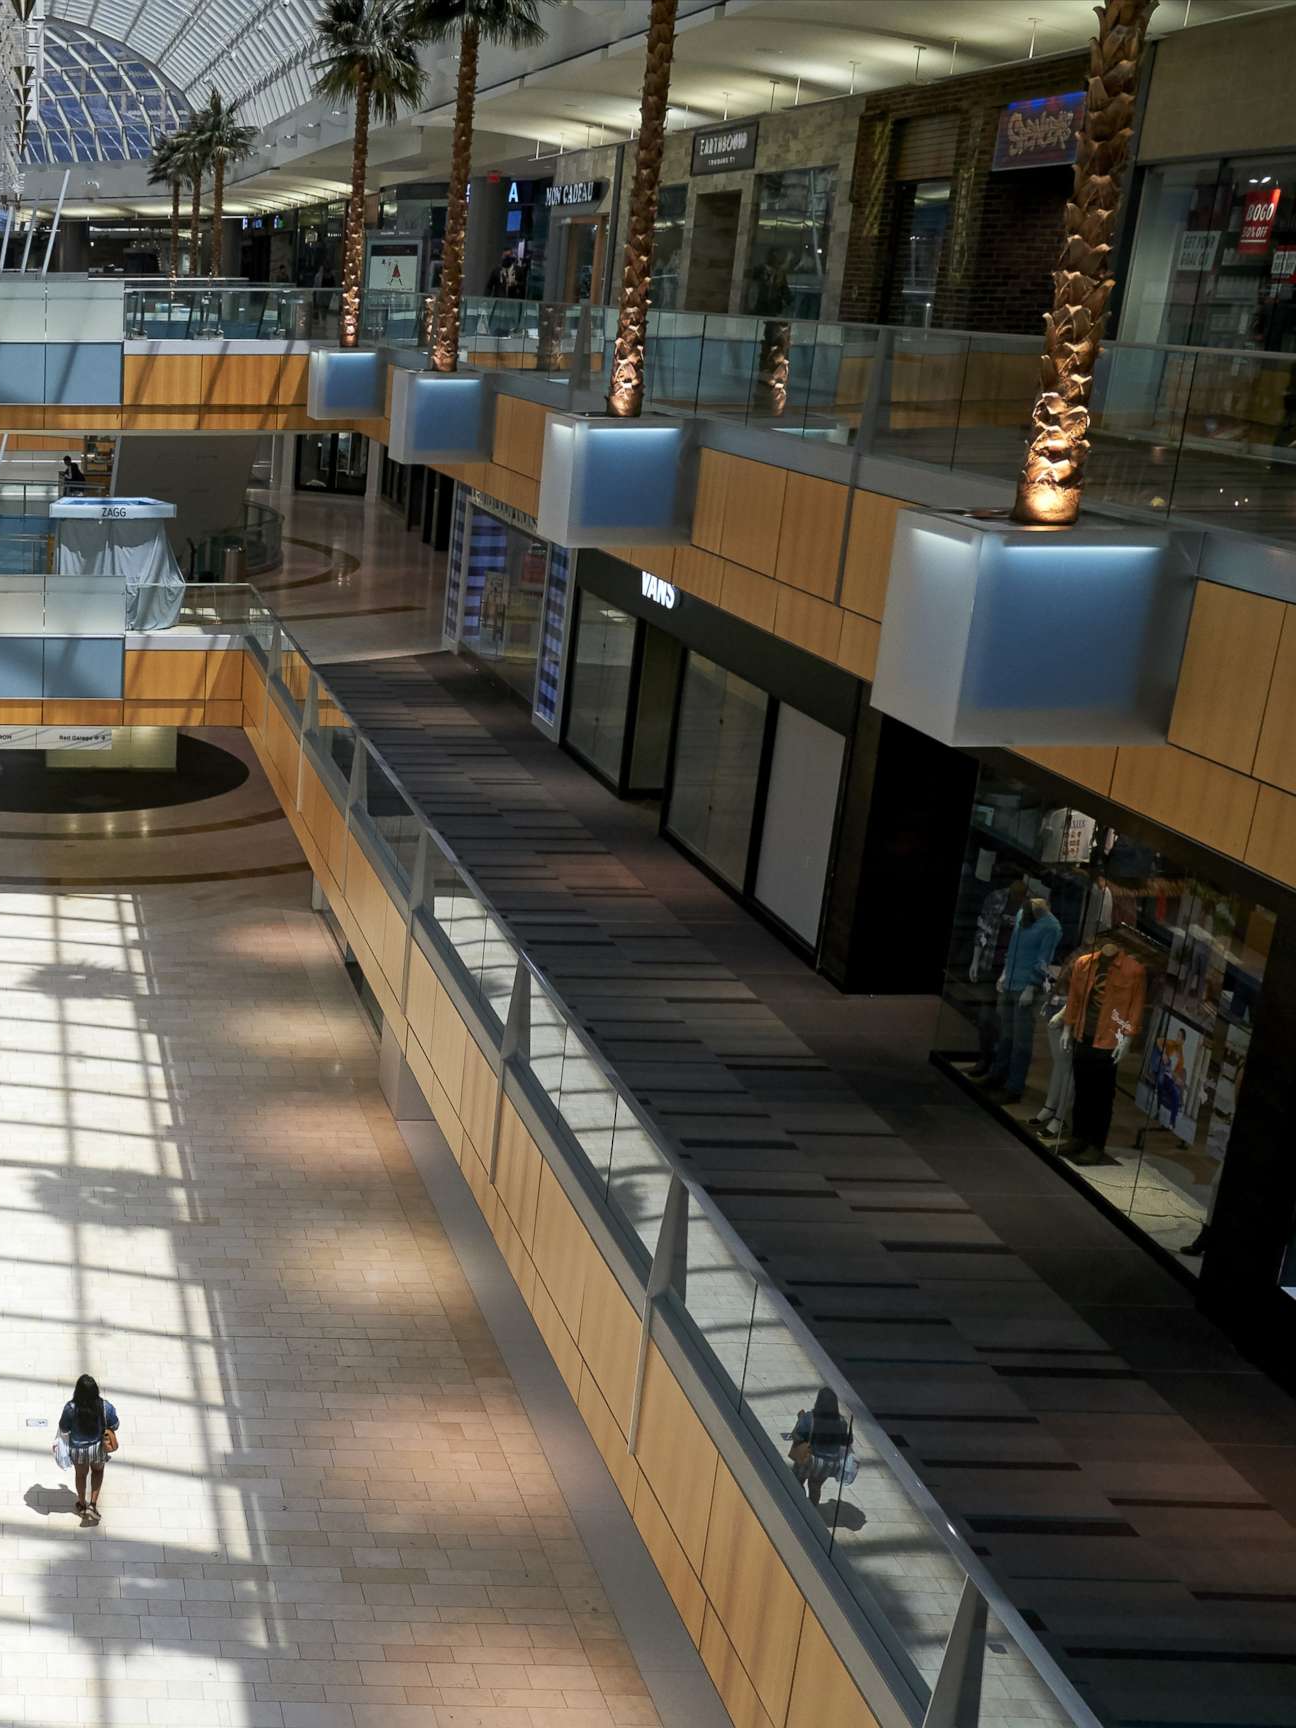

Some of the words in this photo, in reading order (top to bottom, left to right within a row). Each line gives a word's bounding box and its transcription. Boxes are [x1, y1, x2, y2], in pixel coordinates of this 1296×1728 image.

[699, 131, 749, 156] EARTHBOUND
[545, 185, 563, 207] MON
[562, 180, 595, 205] CADEAU
[1246, 202, 1276, 222] BOGO
[1255, 224, 1271, 238] OFF
[102, 507, 127, 518] ZAGG
[641, 570, 675, 609] VANS
